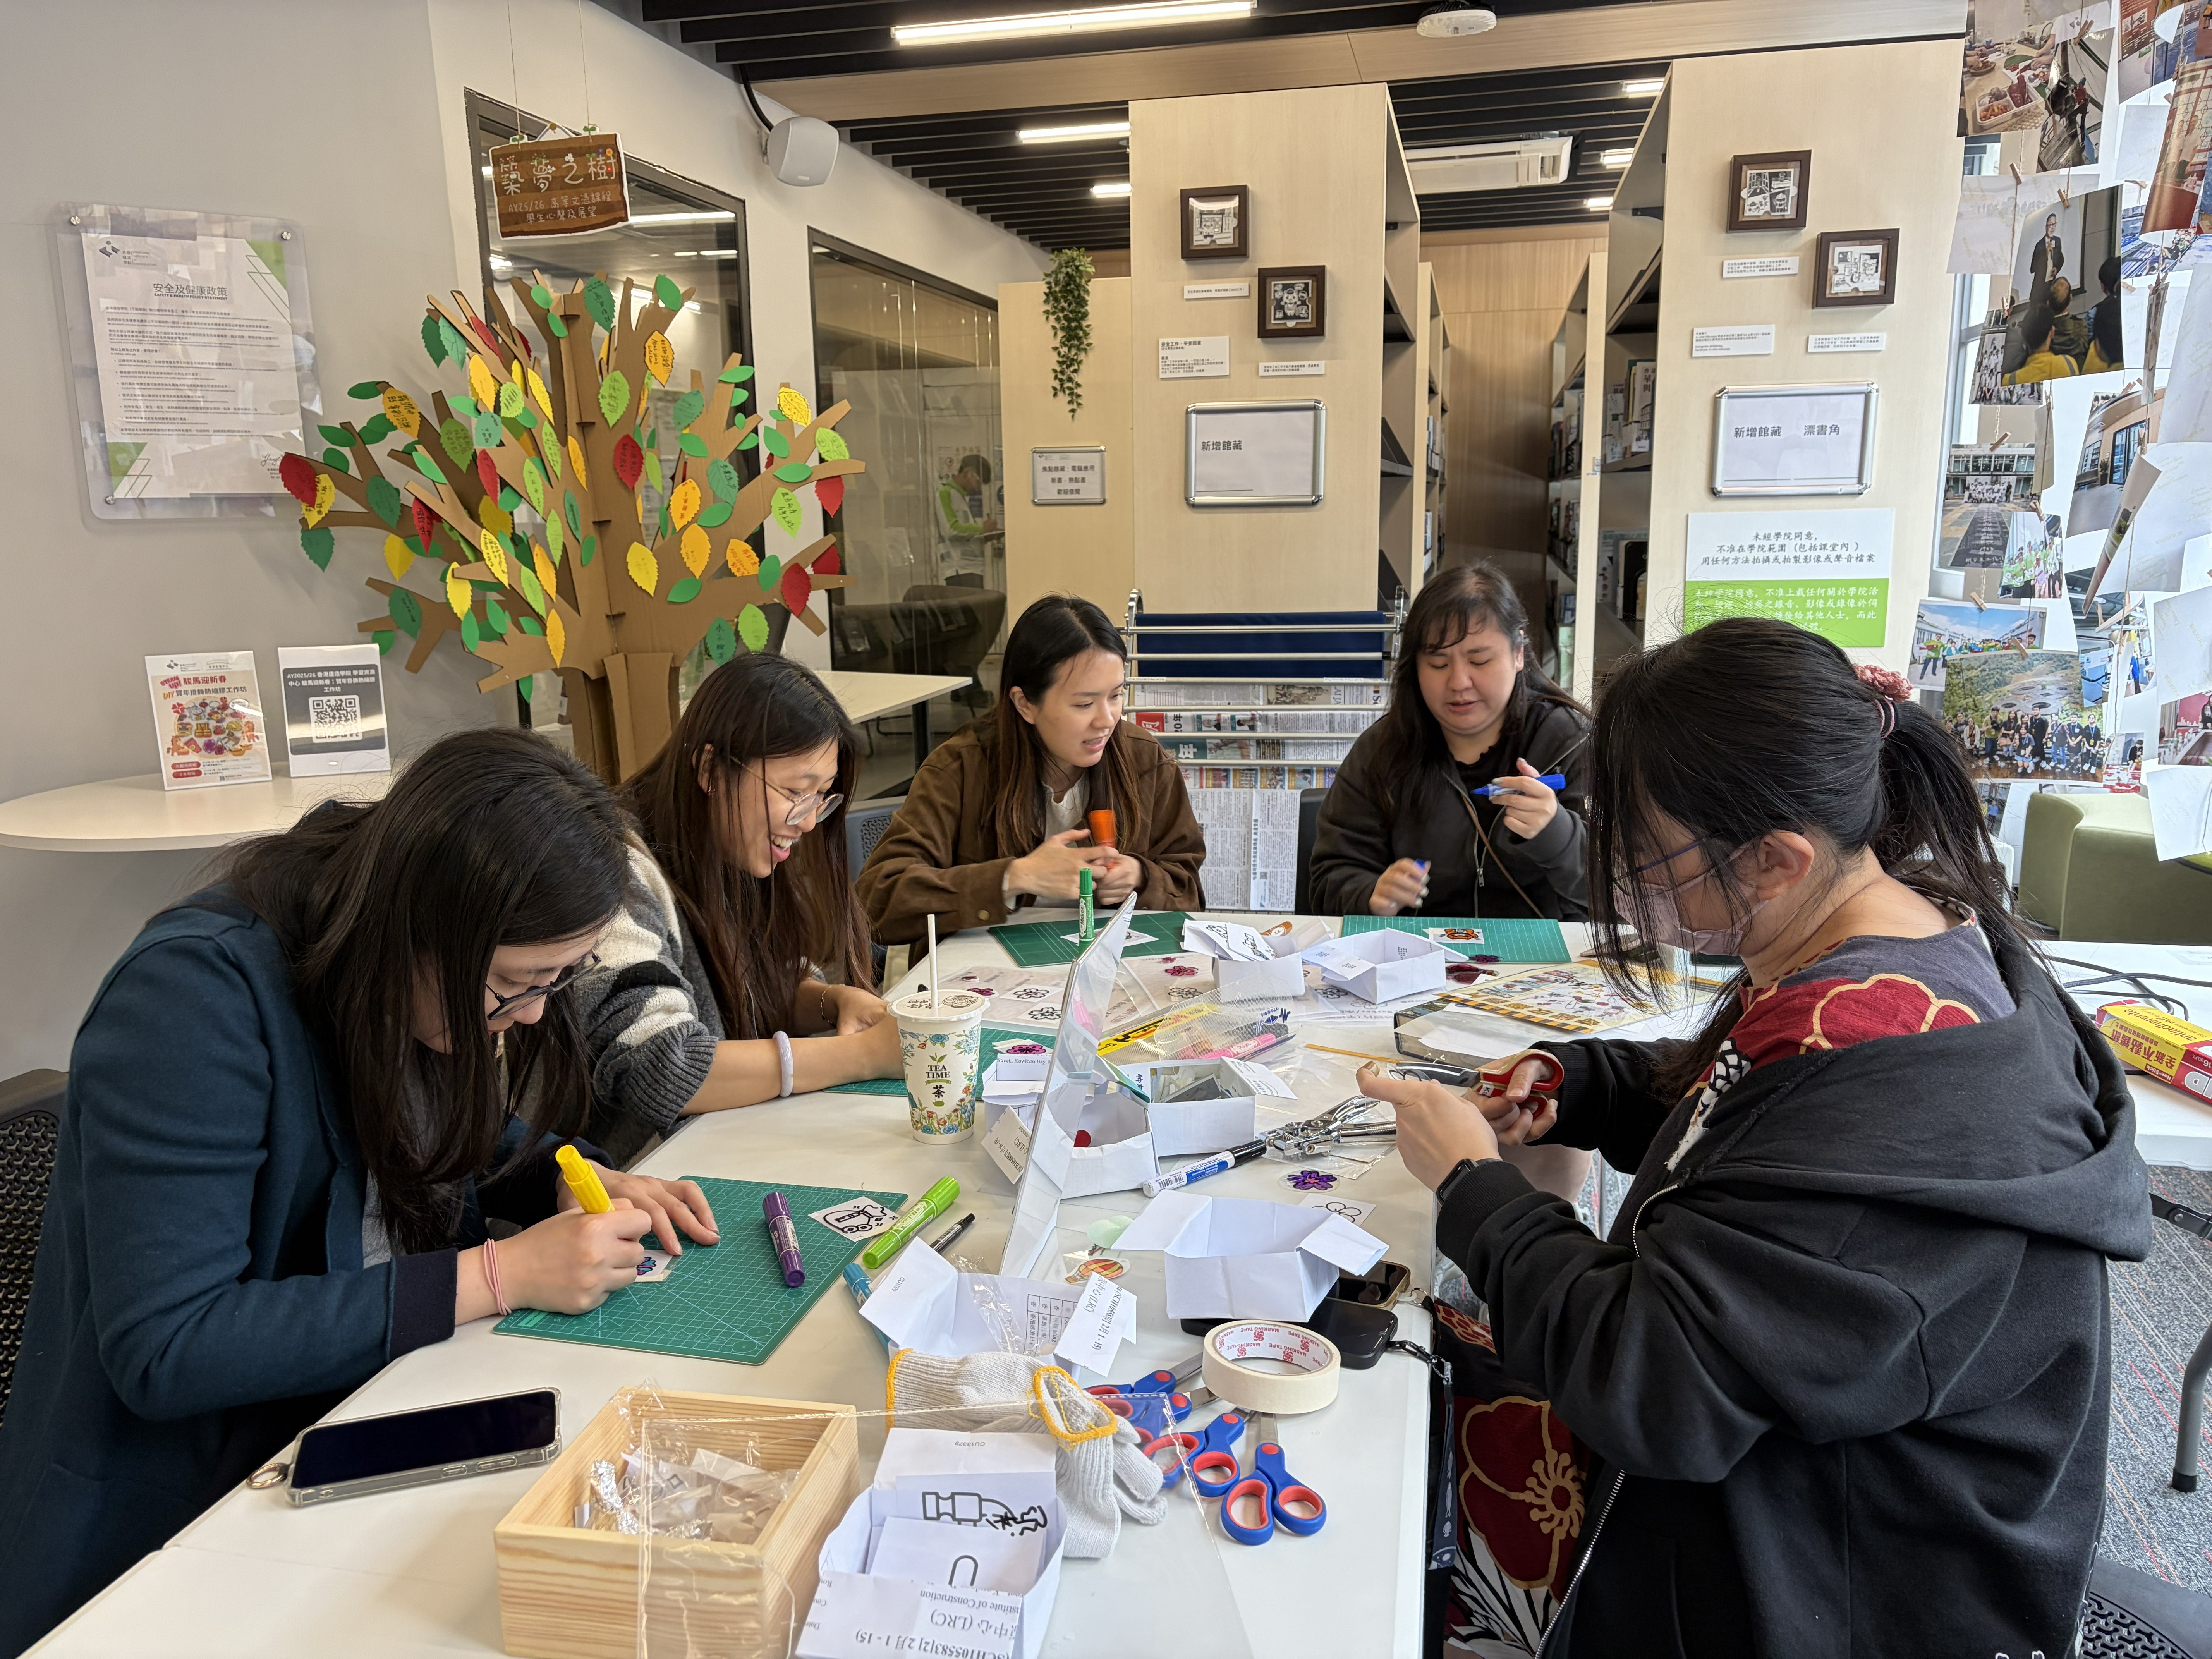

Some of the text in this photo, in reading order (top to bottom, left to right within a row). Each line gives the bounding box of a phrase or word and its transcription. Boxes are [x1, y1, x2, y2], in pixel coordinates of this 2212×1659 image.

[500, 154, 616, 196] 築夢之樹
[153, 283, 228, 297] 安全及健康政策
[1734, 426, 1782, 438] 新增館藏
[1201, 440, 1242, 451] 新增館藏
[162, 691, 175, 700] DIY
[2124, 1008, 2197, 1041] antiadherente
[932, 1084, 946, 1098] 茶
[1082, 1294, 1098, 1313] (LRC)
[1288, 1330, 1320, 1348] MASKING TAPE
[1283, 1346, 1307, 1357] MASKING
[919, 1590, 975, 1608] Construction
[976, 1600, 988, 1610] of
[931, 1609, 973, 1626] (LRC)
[855, 1629, 872, 1644] 15)
